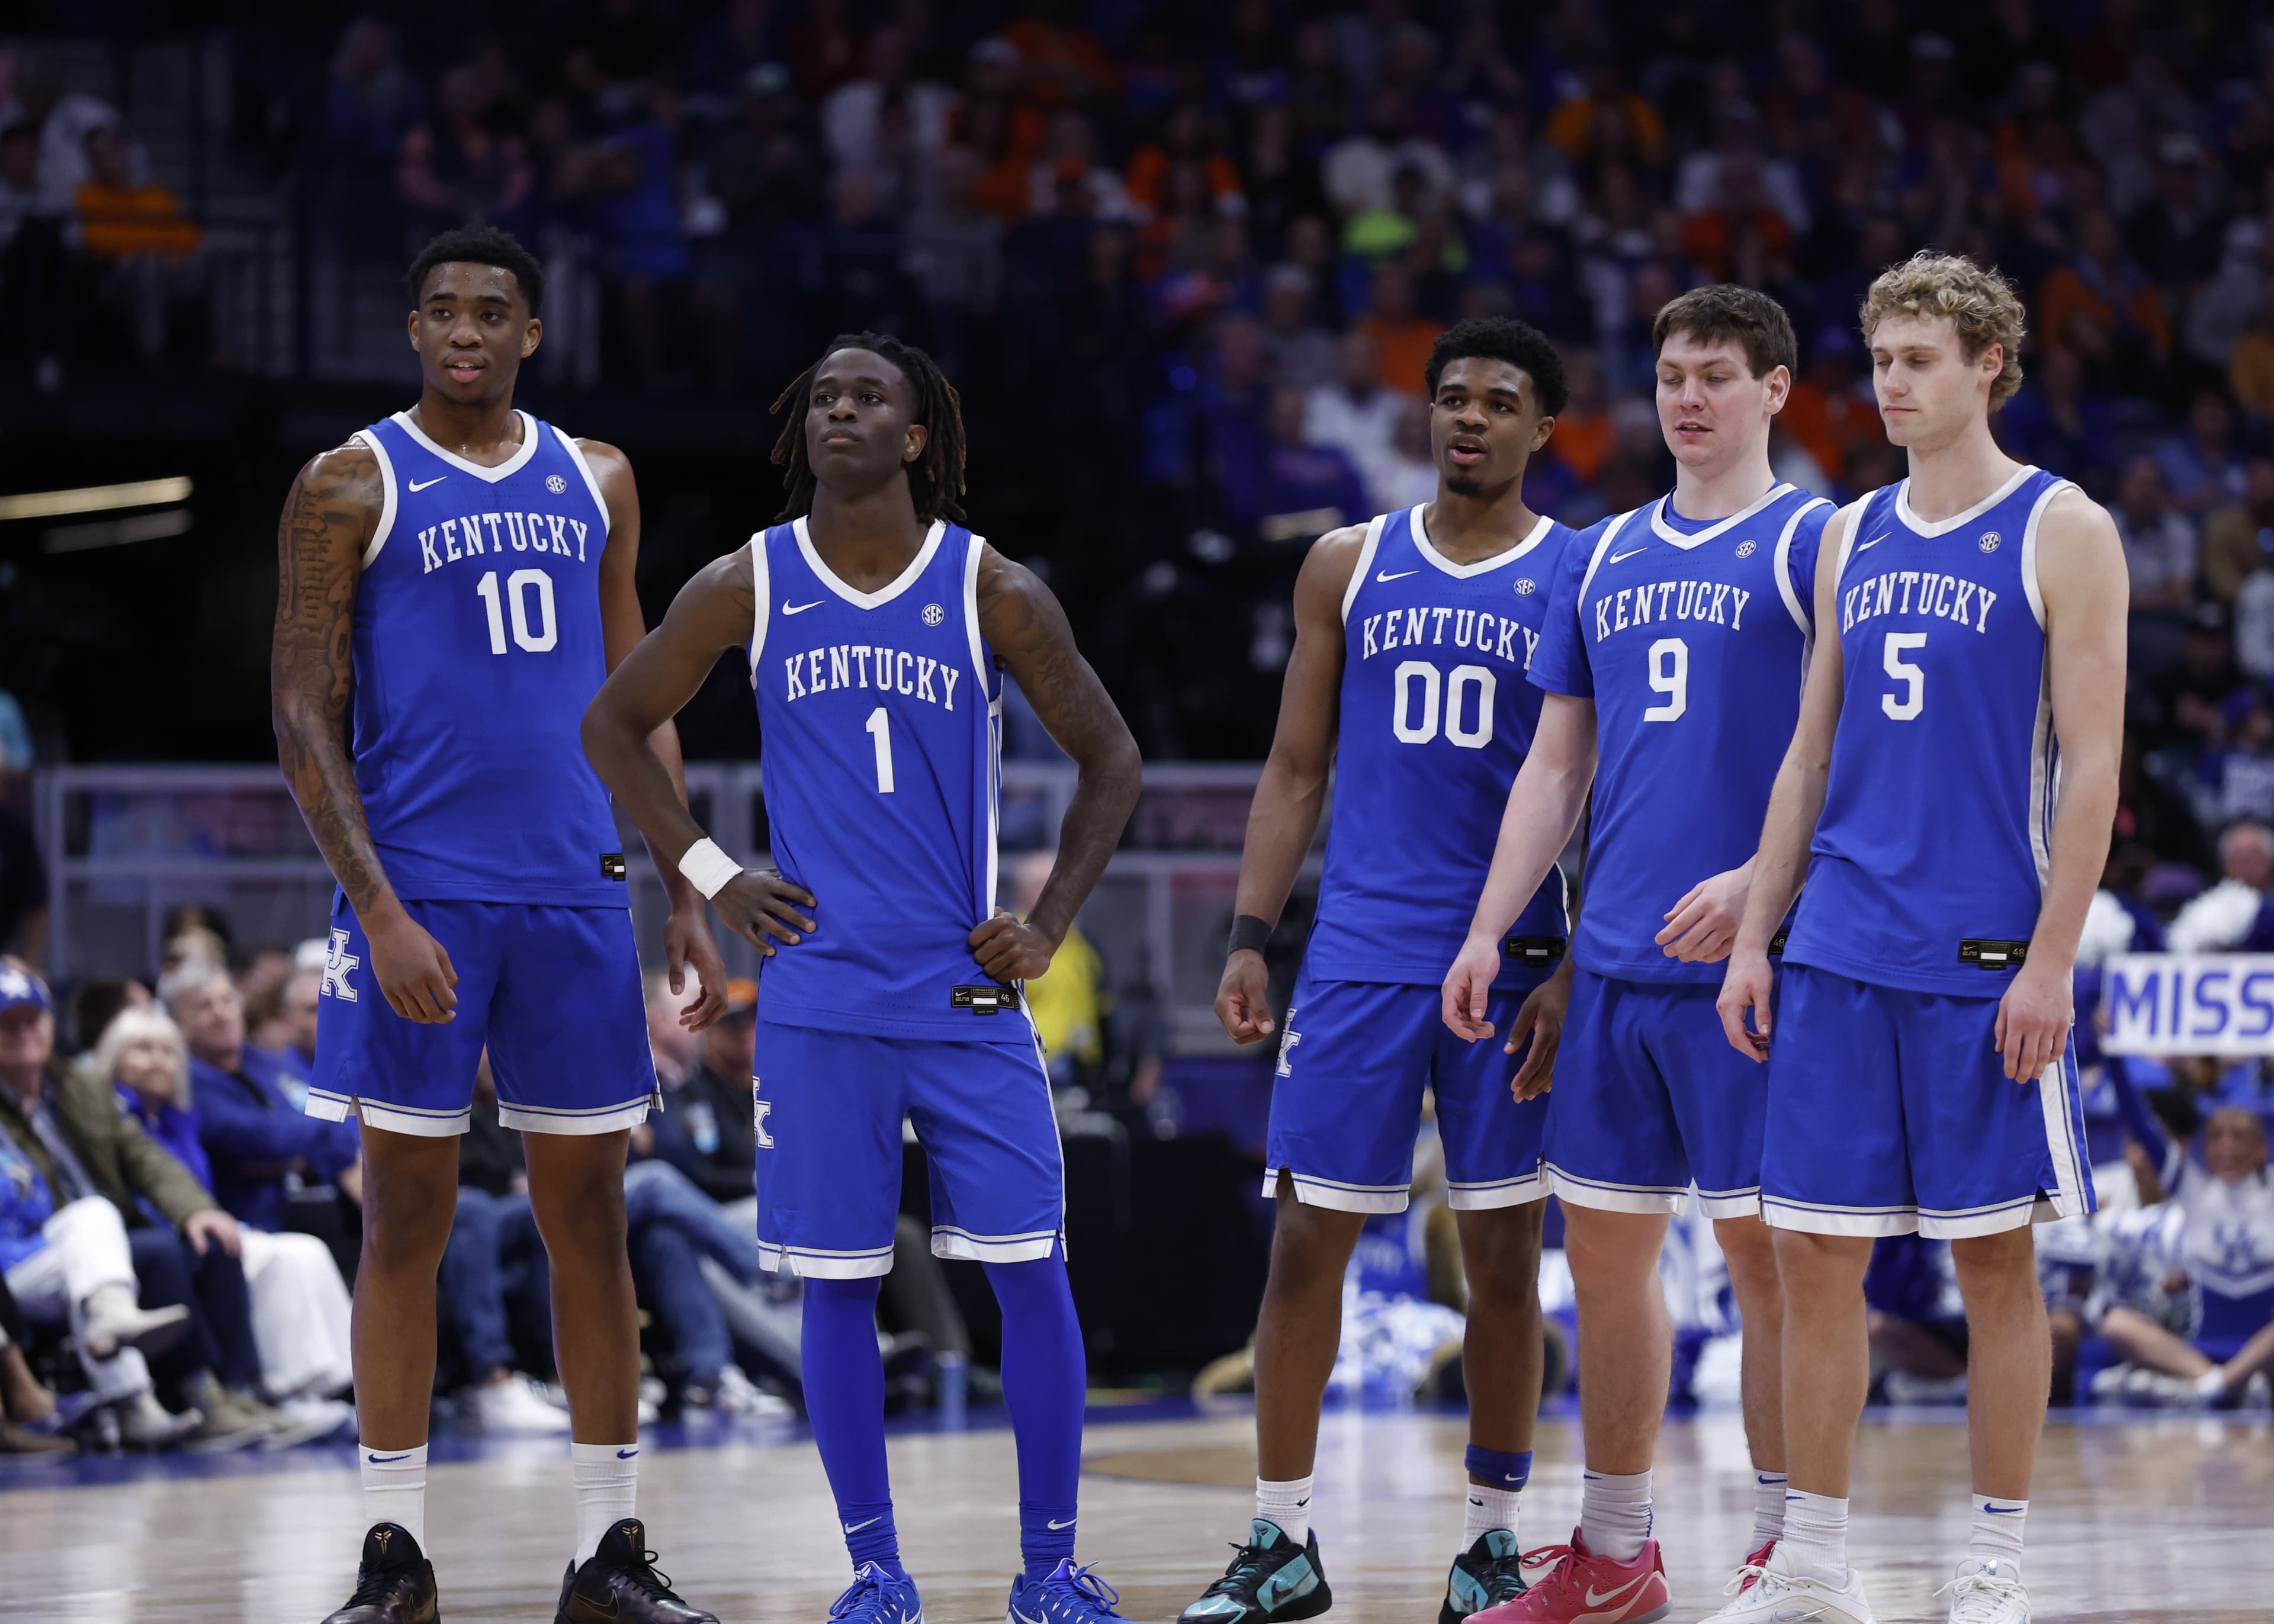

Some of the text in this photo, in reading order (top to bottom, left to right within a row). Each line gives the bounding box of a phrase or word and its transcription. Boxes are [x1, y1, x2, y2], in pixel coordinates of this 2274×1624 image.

[547, 476, 566, 492] SEC
[417, 512, 587, 574] KENTUCKY
[1737, 542, 1755, 556] SEC
[1980, 533, 1999, 551] SEC
[477, 568, 557, 655] 10
[924, 605, 942, 624] SEC
[1516, 580, 1533, 595] SEC
[1596, 580, 1750, 643] KENTUCKY
[1843, 571, 1997, 635] KENTUCKY
[1363, 607, 1540, 671] KENTUCKY
[785, 644, 959, 711] KENTUCKY
[1393, 661, 1496, 749] 00
[1643, 638, 1688, 722] 9
[1881, 632, 1928, 721] 5
[865, 707, 895, 793] 1
[2110, 971, 2274, 1035] MISS
